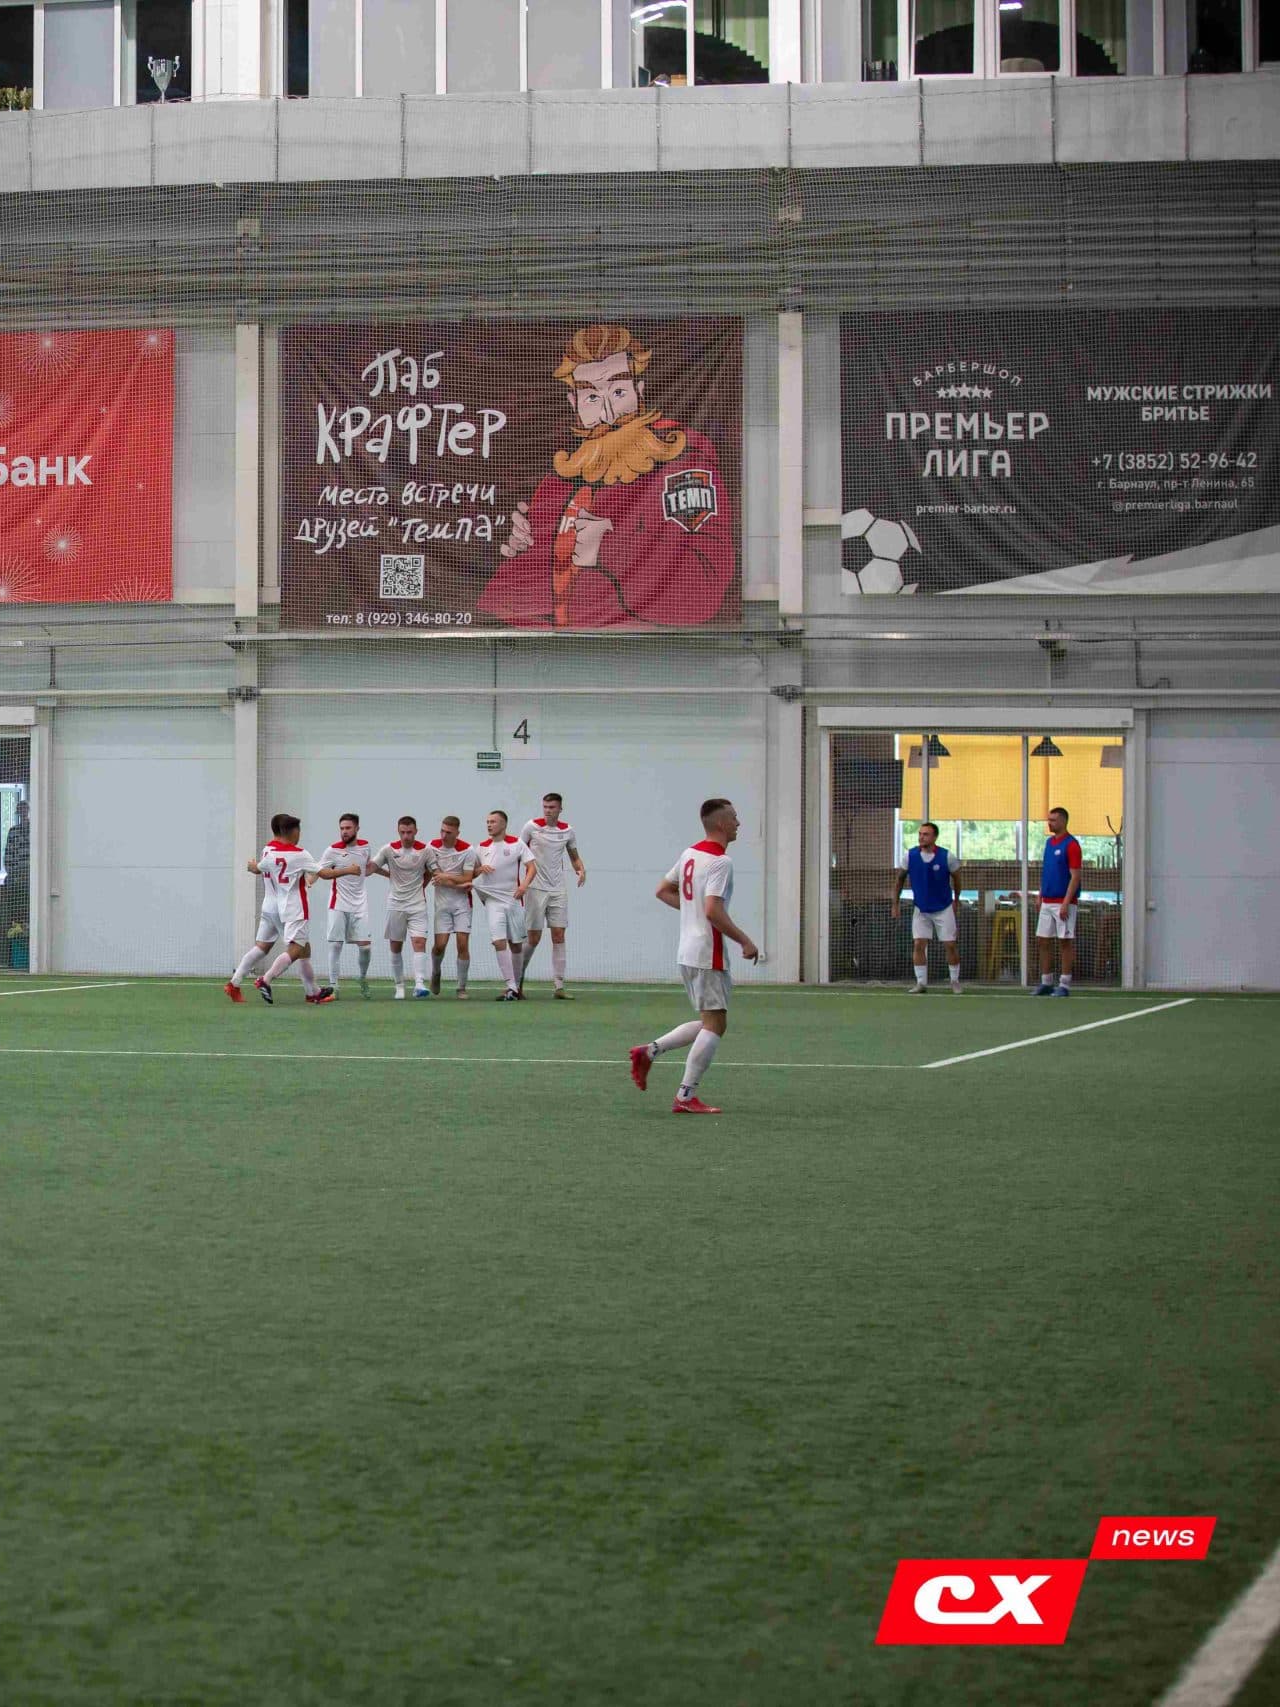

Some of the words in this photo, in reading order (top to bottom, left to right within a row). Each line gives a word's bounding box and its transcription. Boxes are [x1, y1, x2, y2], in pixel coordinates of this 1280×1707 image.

[362, 348, 445, 397] Паб
[913, 361, 1022, 387] БАРБЕРШОП
[1087, 385, 1178, 401] МУЖСКИЕ
[1182, 384, 1272, 400] СТРИЖКИ
[886, 412, 1050, 440] ПРЕМЬЕР
[1141, 406, 1210, 421] БРИТЬЕ
[922, 449, 1012, 477] ЛИГА
[1092, 454, 1113, 469] +7
[1119, 452, 1174, 471] (3852)
[1180, 452, 1258, 469] 52-96-42
[1109, 478, 1161, 491] Барнаул,
[1241, 477, 1255, 488] 65
[667, 487, 712, 512] ТЕМП
[916, 502, 1017, 516] premier-barber.ru
[326, 614, 352, 625] тел:
[356, 613, 364, 624] 8
[368, 612, 401, 626] (929)
[405, 612, 472, 624] 346-80-20
[513, 719, 531, 745] 4
[275, 857, 290, 884] 2
[682, 858, 695, 901] 8
